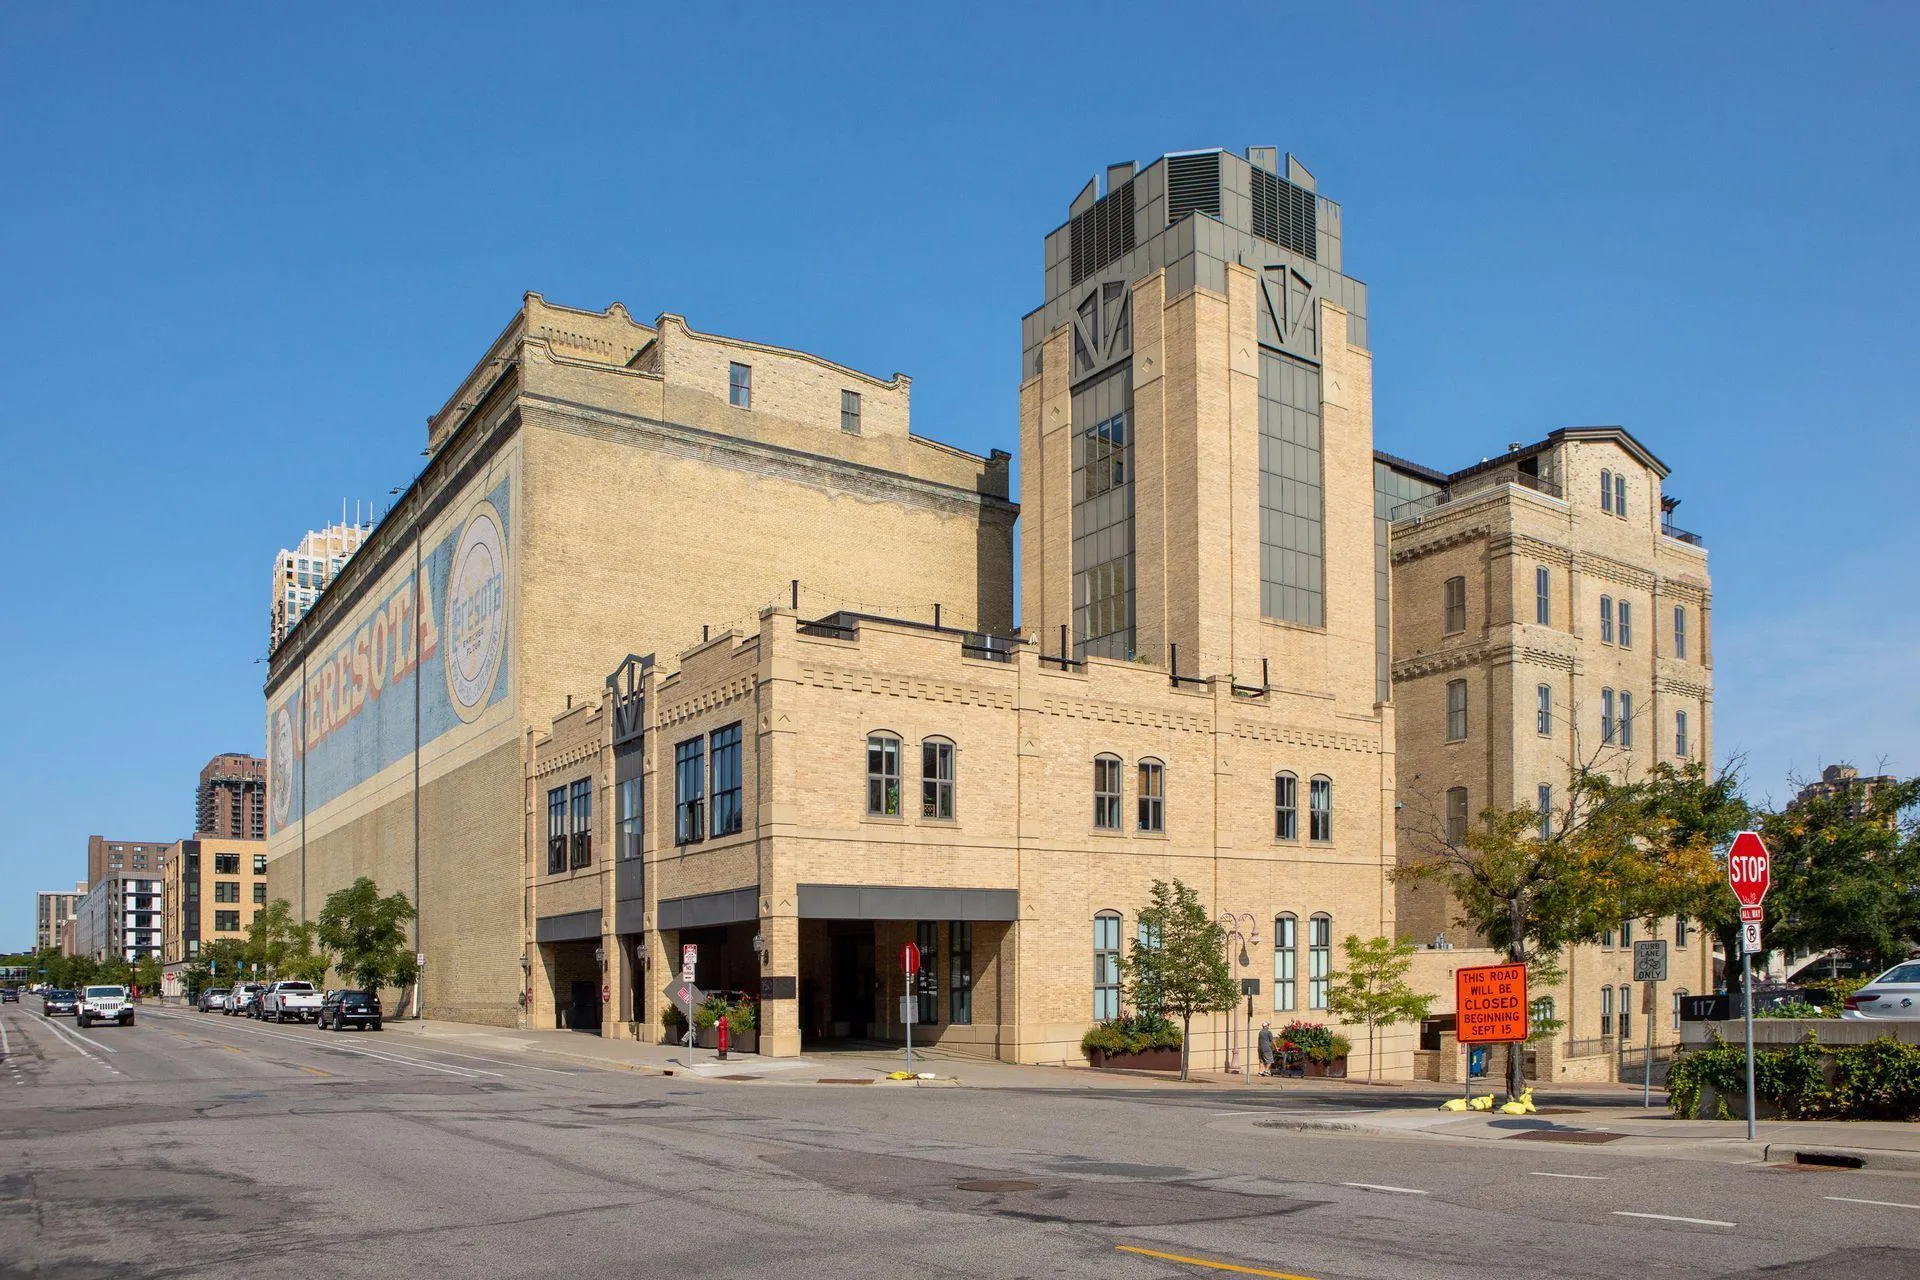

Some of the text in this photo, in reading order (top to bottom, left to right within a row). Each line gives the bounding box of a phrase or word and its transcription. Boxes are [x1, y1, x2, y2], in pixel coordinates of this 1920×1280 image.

[295, 563, 439, 760] CERESOTA
[1731, 855, 1766, 883] STOP
[1742, 909, 1761, 919] ALL WAY
[1640, 942, 1660, 950] CURB
[1463, 970, 1518, 983] THIS ROAD
[1638, 971, 1661, 979] ONLY
[1470, 984, 1512, 996] WILL BE
[1464, 997, 1518, 1011] CLOSED
[1692, 1000, 1716, 1016] 117
[1464, 1012, 1520, 1024] BEGINNING
[1471, 1025, 1512, 1036] SEPT 15
